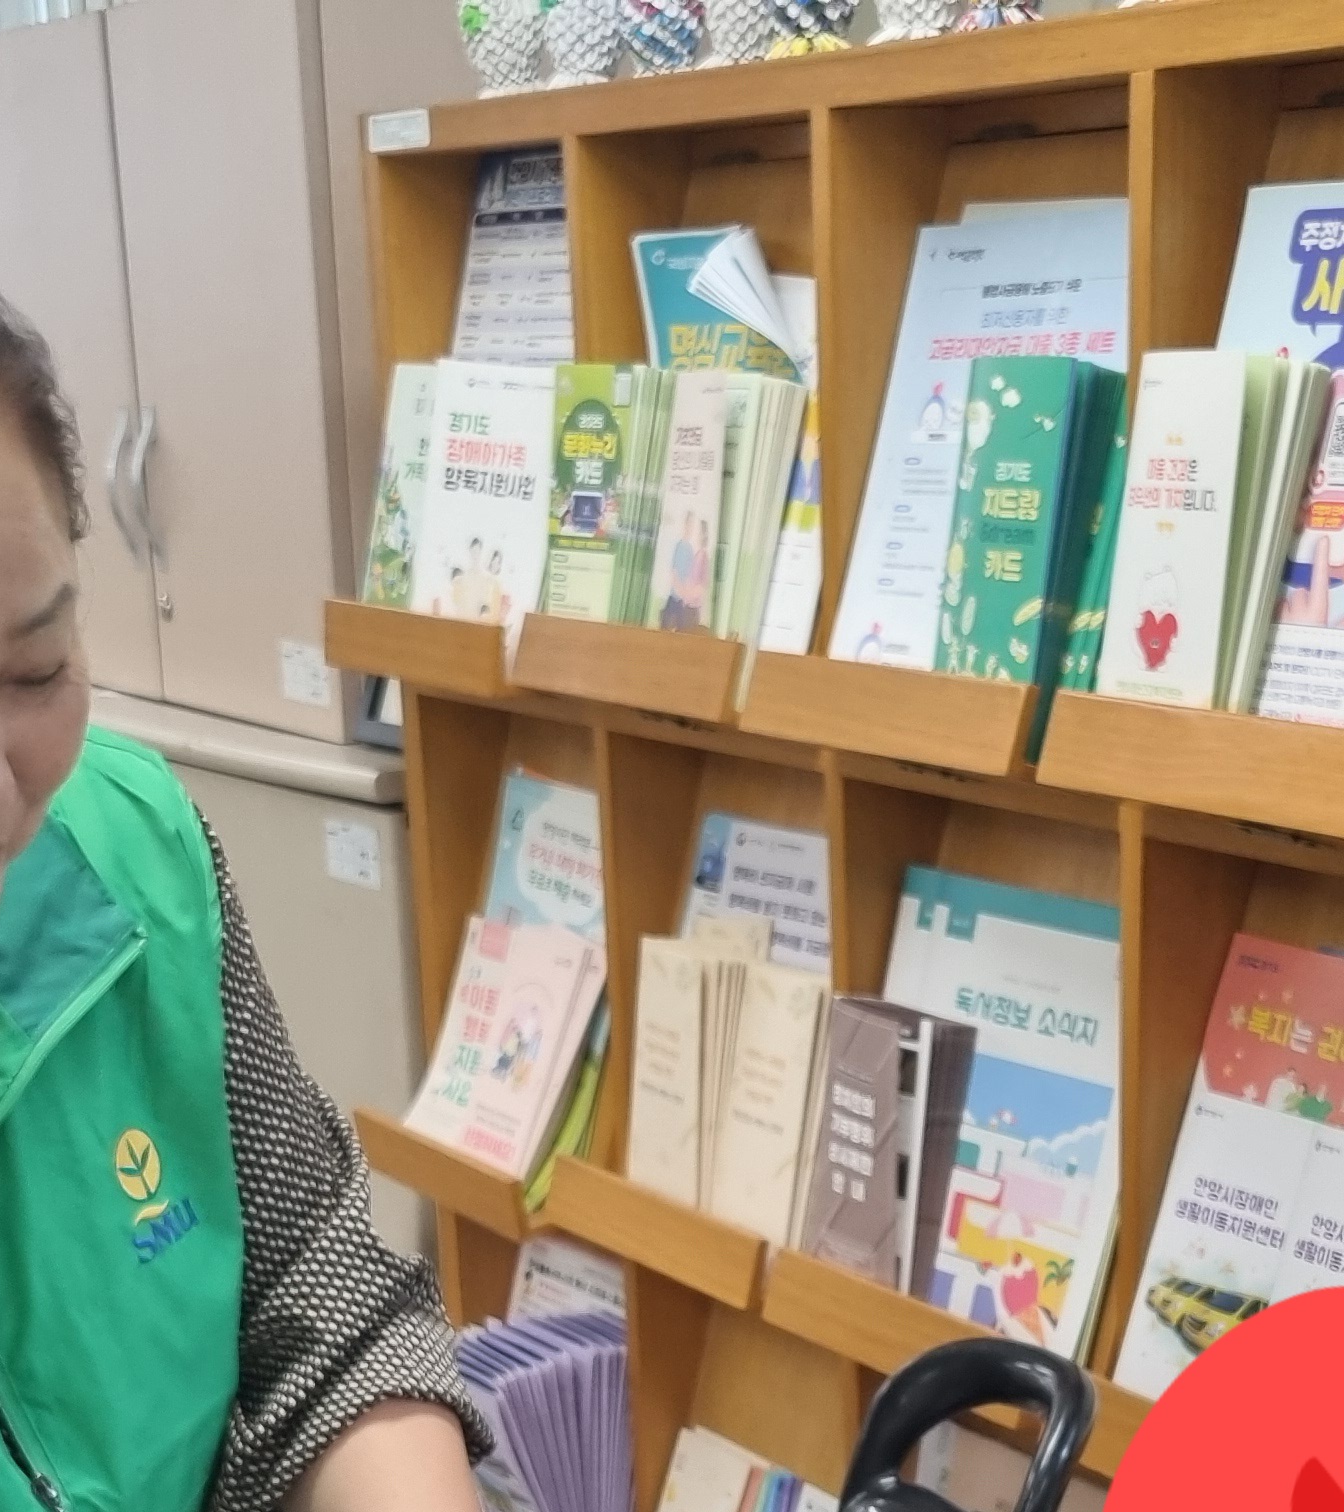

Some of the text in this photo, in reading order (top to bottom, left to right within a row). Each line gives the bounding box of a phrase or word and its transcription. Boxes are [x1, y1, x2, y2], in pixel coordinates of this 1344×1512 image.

[449, 411, 491, 436] 경기도
[445, 438, 528, 469] 장애아가족
[443, 466, 536, 502] 양육지원사업
[983, 549, 1024, 583] 카드
[1036, 1006, 1099, 1048] 소식지
[1247, 1004, 1313, 1055] 복지는
[1192, 1175, 1279, 1221] 안양시장애인
[132, 1198, 200, 1264] SMU
[1173, 1197, 1286, 1251] 생활이동지원센터
